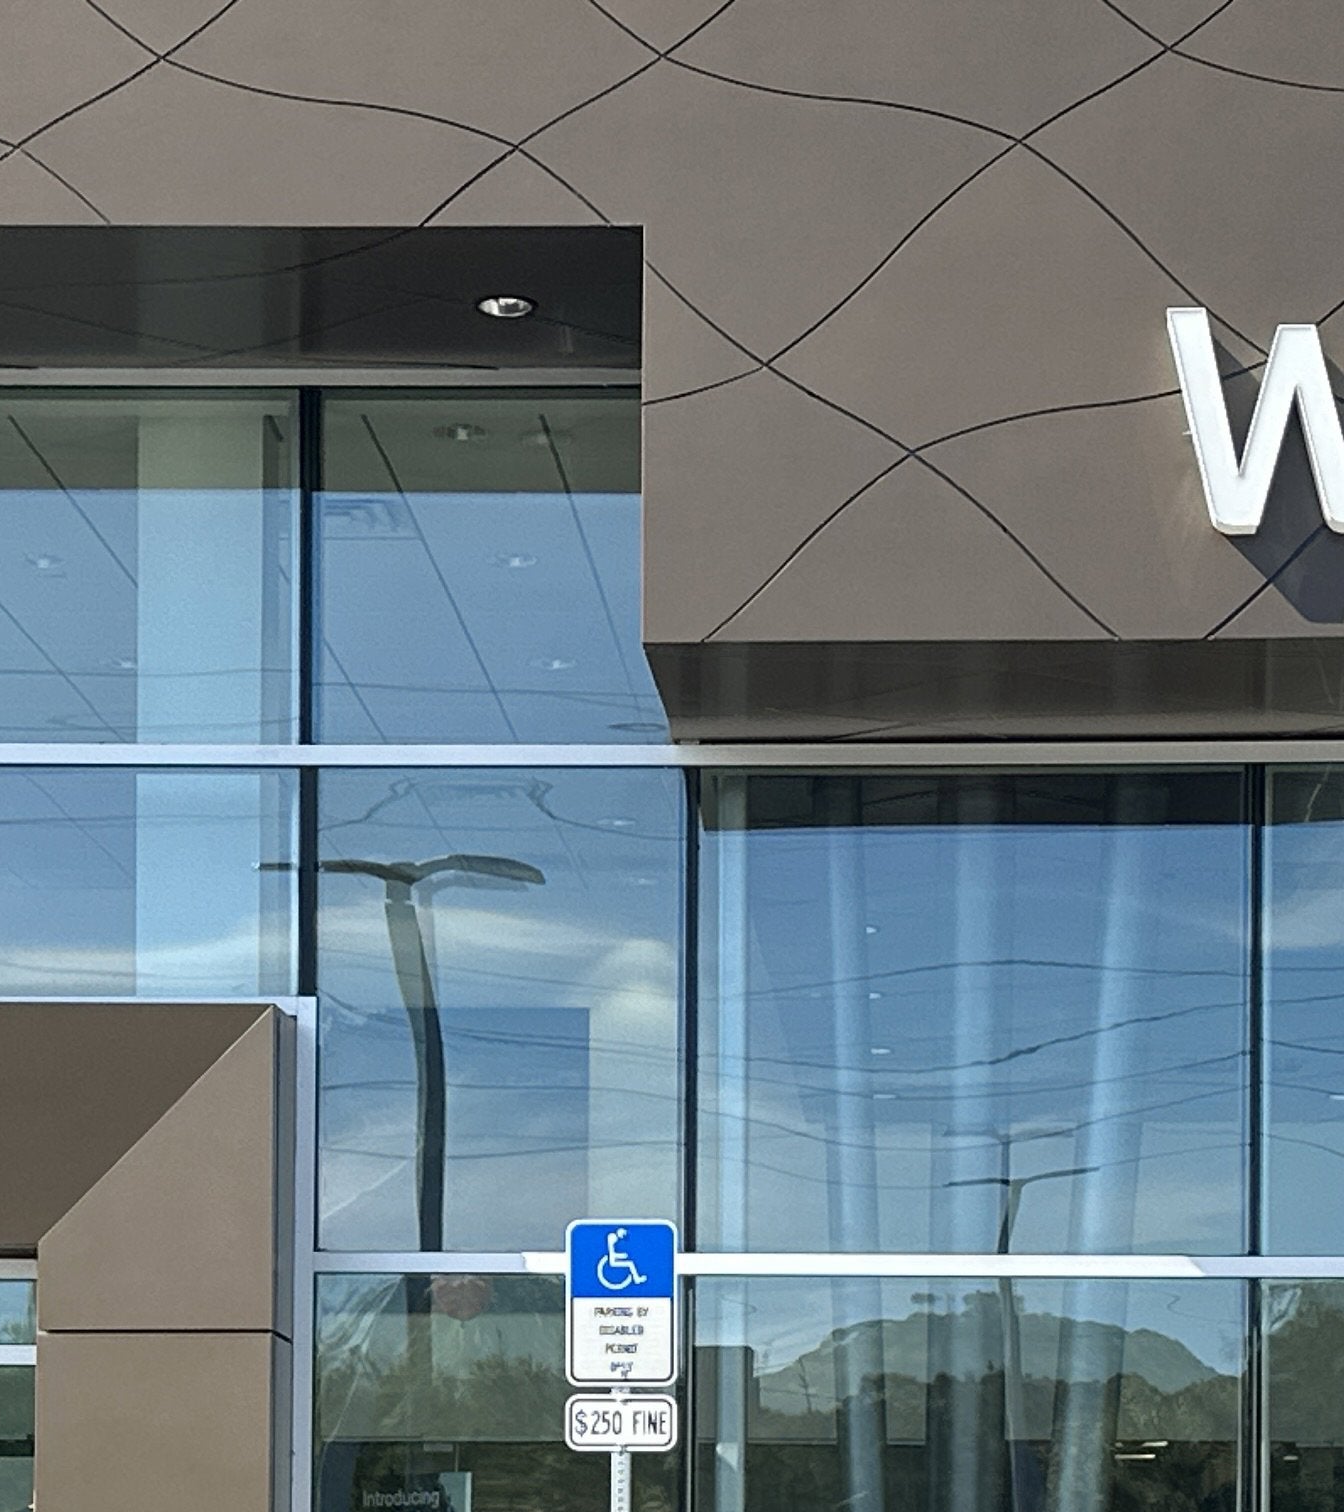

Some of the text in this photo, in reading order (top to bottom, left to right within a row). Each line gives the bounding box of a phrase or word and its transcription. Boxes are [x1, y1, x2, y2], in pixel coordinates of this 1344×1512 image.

[574, 1409, 668, 1437] $250 FINE
[362, 1489, 440, 1508] Introducing
